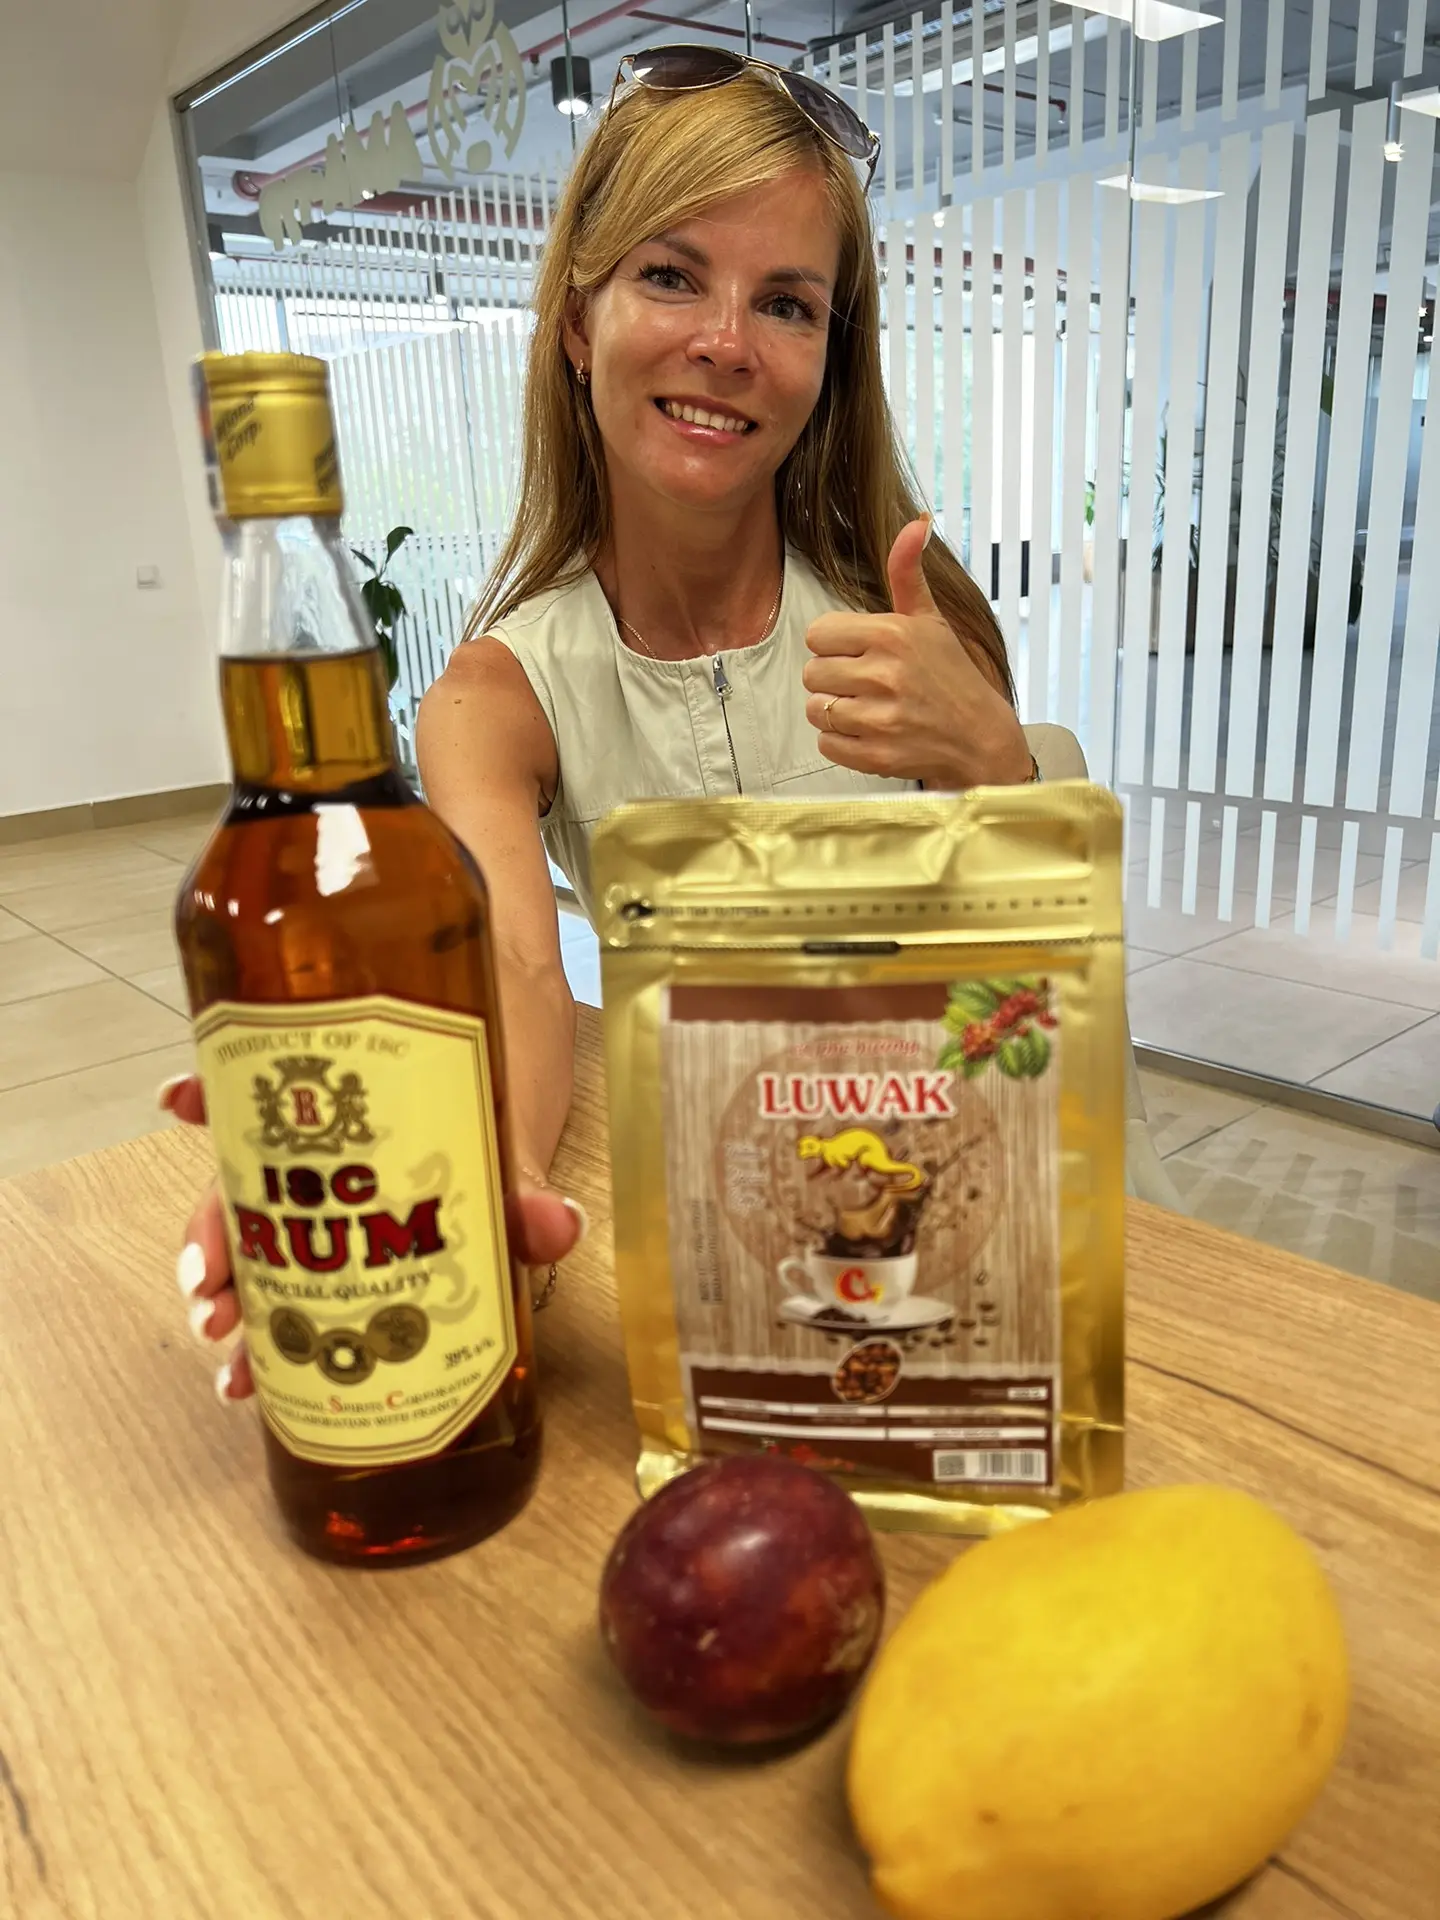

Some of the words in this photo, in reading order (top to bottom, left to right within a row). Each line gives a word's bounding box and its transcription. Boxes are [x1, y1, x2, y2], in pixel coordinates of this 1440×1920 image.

[217, 1032, 316, 1064] PRODUCT
[322, 1032, 359, 1050] OF
[290, 1087, 324, 1126] R
[762, 1072, 953, 1117] LUWAK
[235, 1197, 447, 1272] RUM
[254, 1275, 325, 1300] SPECIAL
[331, 1270, 433, 1300] QUALITY
[386, 1371, 481, 1411] CORPORATION
[376, 1413, 410, 1428] WITH
